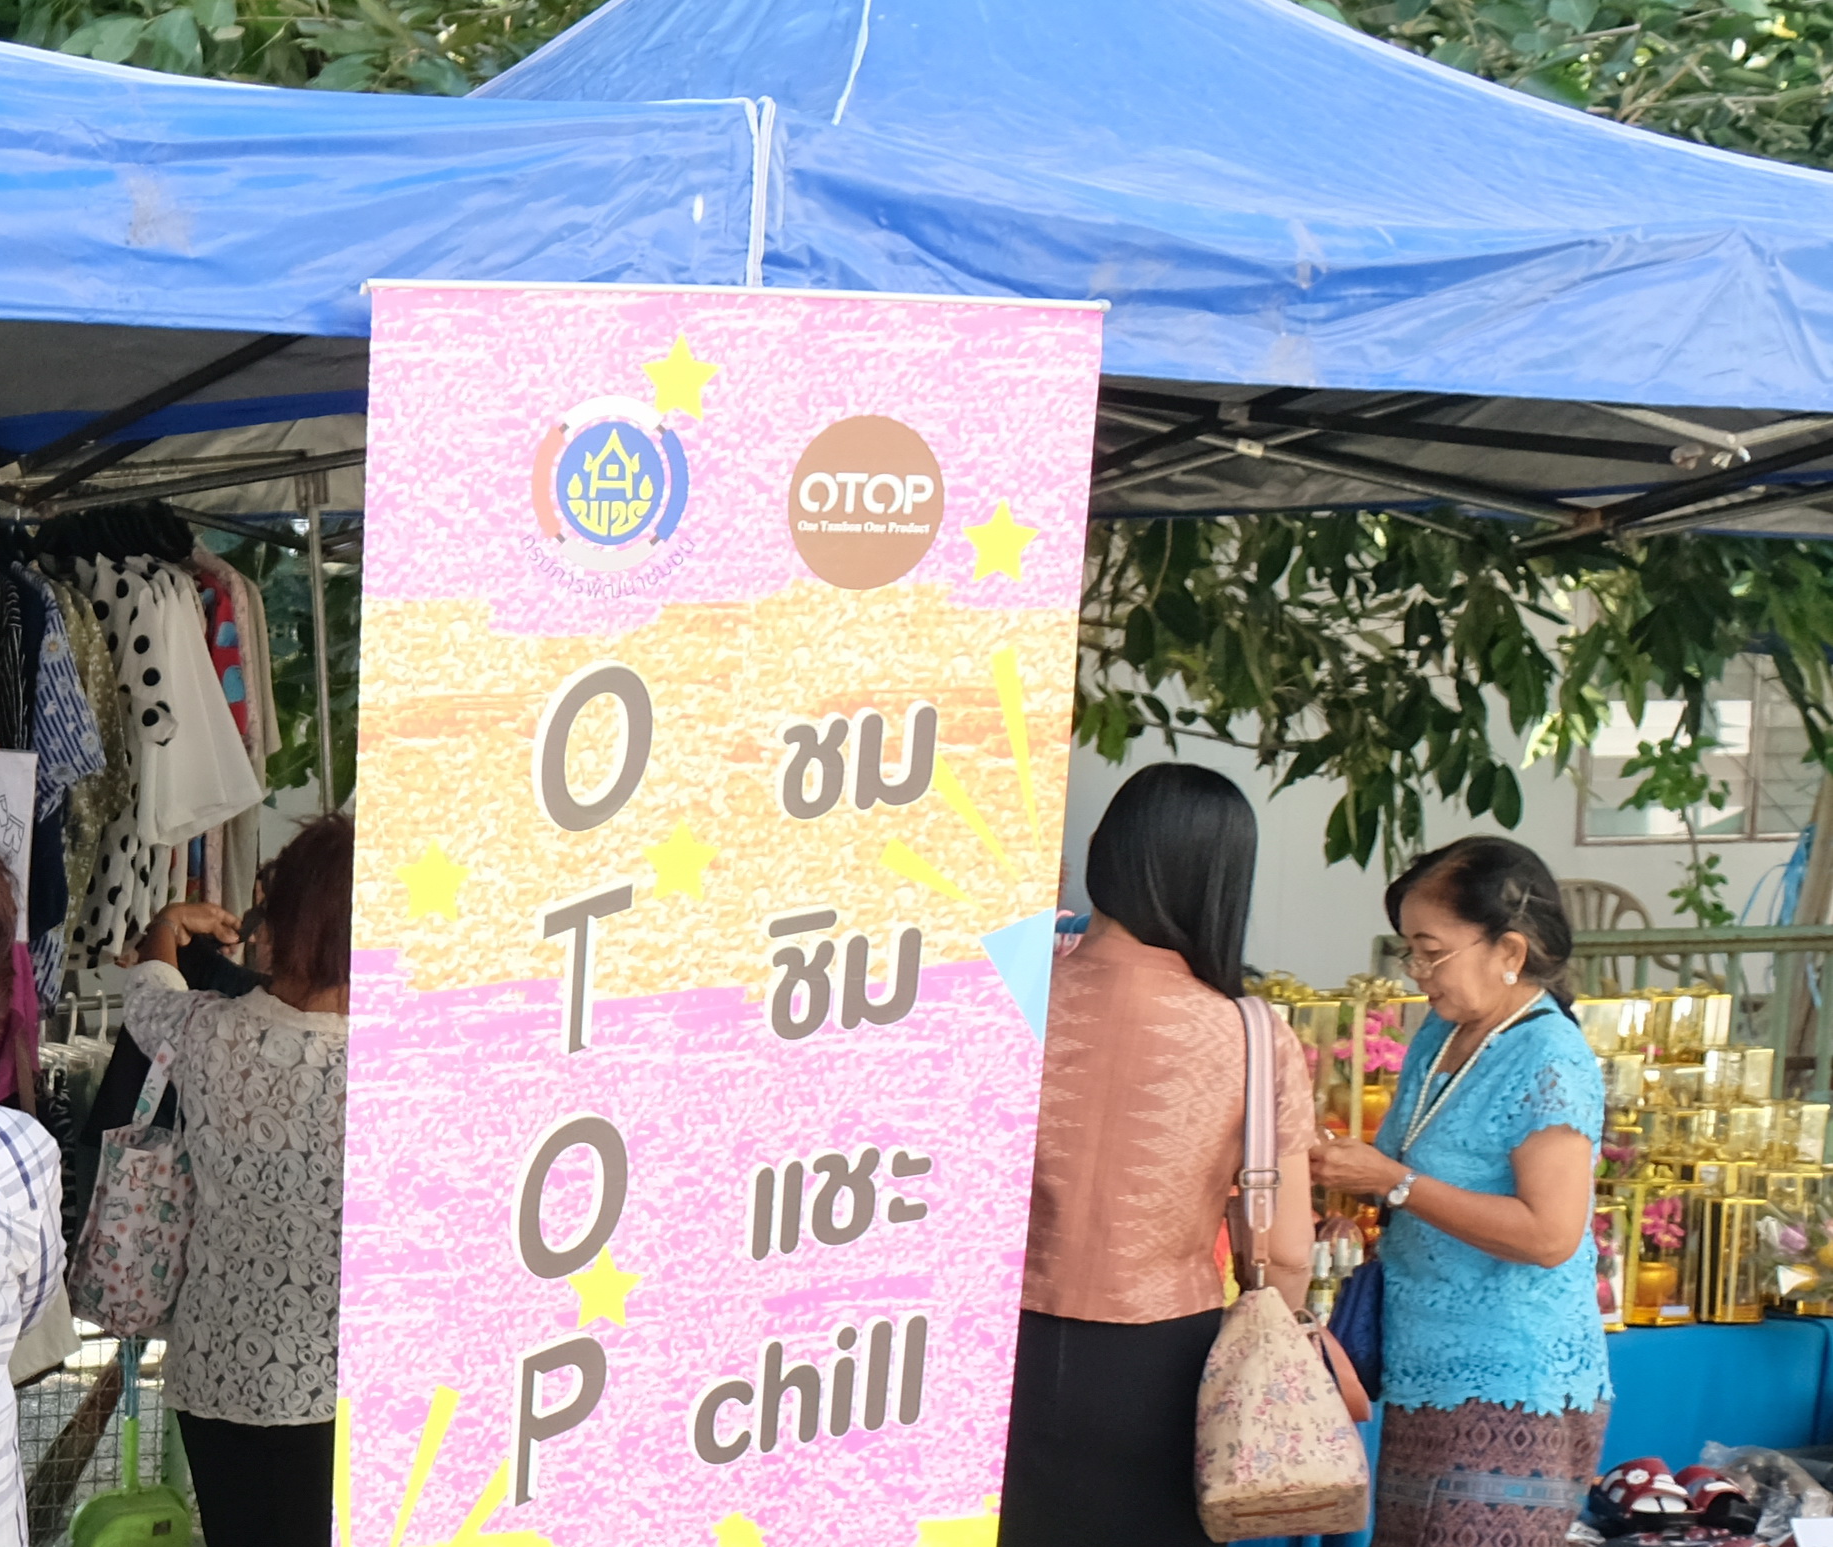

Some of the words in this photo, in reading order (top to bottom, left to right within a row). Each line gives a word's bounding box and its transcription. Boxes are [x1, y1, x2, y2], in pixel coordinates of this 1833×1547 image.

[796, 520, 819, 533] One
[863, 521, 887, 534] One
[798, 471, 935, 514] OTOP
[782, 705, 938, 820] ชม
[767, 909, 923, 1041] ชิม
[751, 1146, 932, 1262] แชะ
[693, 1315, 928, 1465] chill
